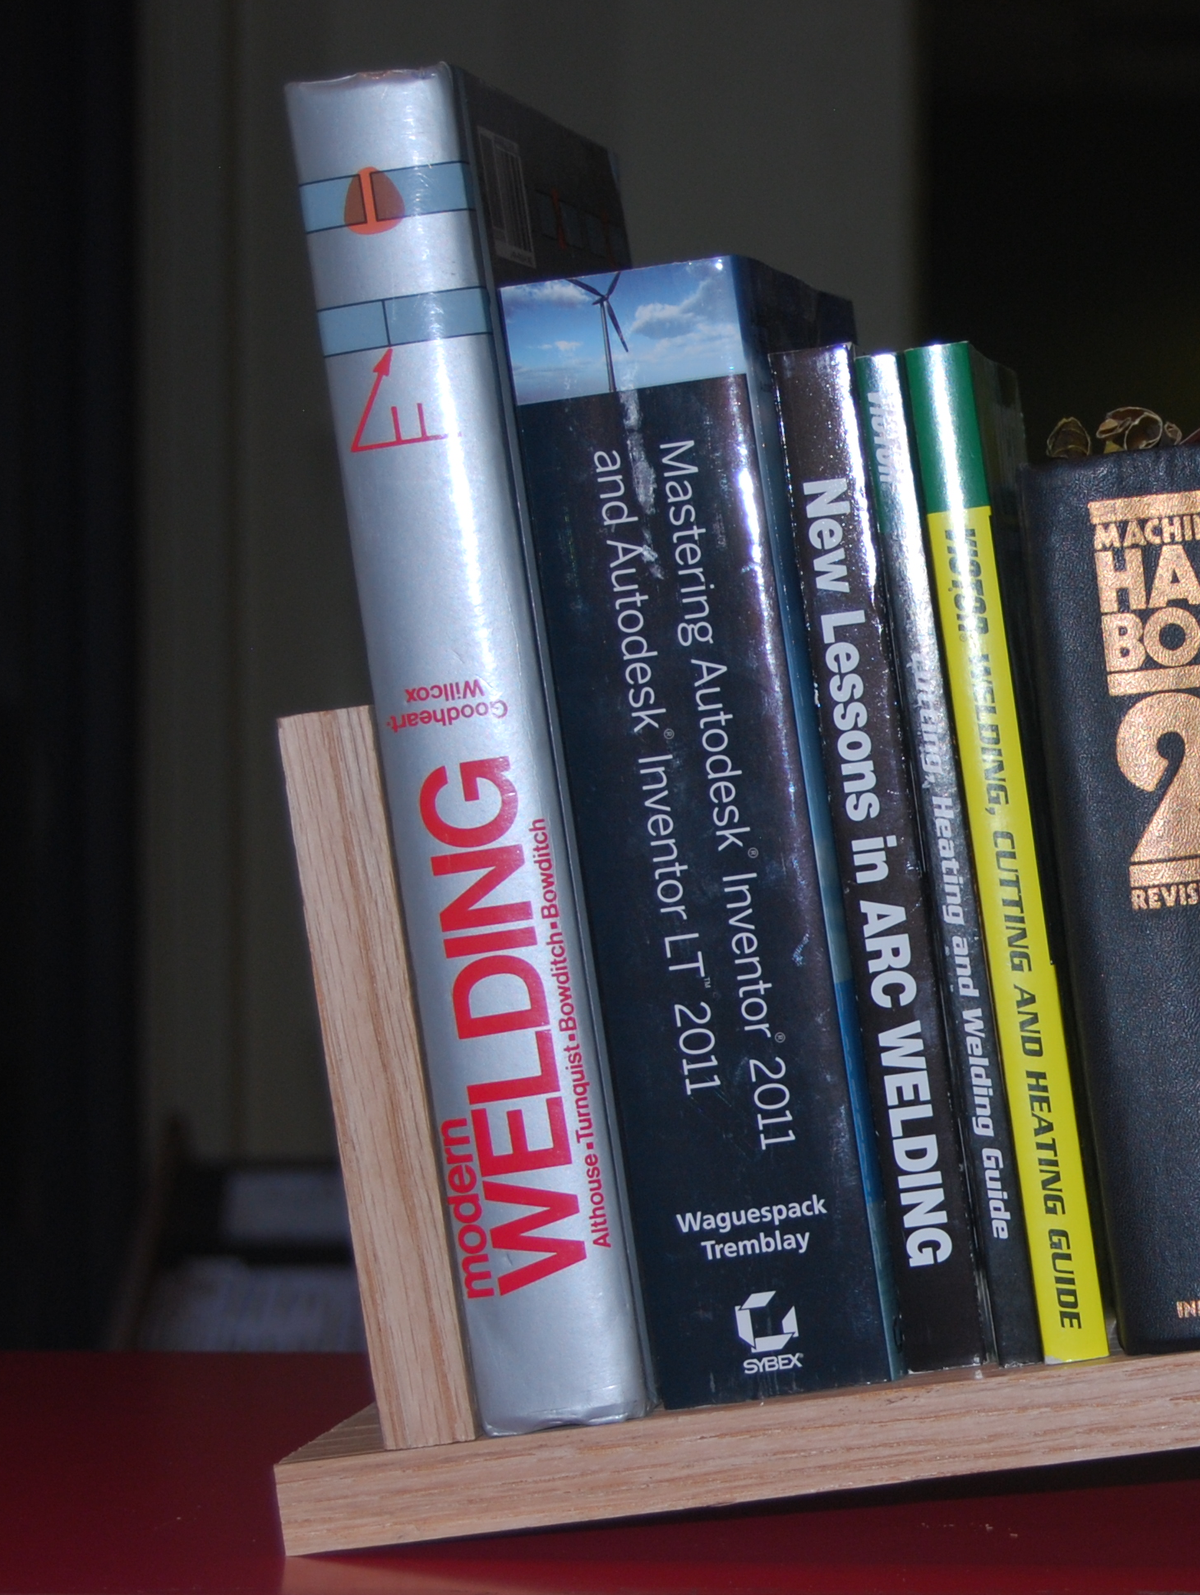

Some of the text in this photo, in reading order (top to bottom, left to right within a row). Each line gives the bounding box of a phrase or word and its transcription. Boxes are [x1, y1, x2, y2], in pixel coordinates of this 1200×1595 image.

[594, 451, 639, 526] and
[405, 679, 485, 703] Willcox
[606, 540, 666, 733] Autodesk
[659, 440, 796, 1150] Mastering Autodesk Inventor 2011
[968, 653, 1009, 816] WELDING,
[638, 754, 688, 920] Inventor
[803, 478, 953, 1267] New Lessons in ARC WELDING
[932, 796, 965, 925] Heating
[992, 829, 1033, 973] CUTTING
[419, 755, 587, 1296] WELDING
[948, 935, 979, 997] and
[1013, 983, 1044, 1057] AND
[529, 818, 611, 1248] Althouse Turnquist Bowditch Bowditch
[674, 1002, 721, 1095] 2011
[960, 1008, 995, 1137] Welding
[982, 1148, 1008, 1240] Guide
[1025, 1070, 1066, 1215] HEATING
[449, 1118, 494, 1298] modern
[676, 1194, 828, 1233] Waguespack
[701, 1230, 810, 1260] Tremblay
[1048, 1228, 1081, 1330] GUIDE
[743, 1353, 803, 1374] SYBEX
